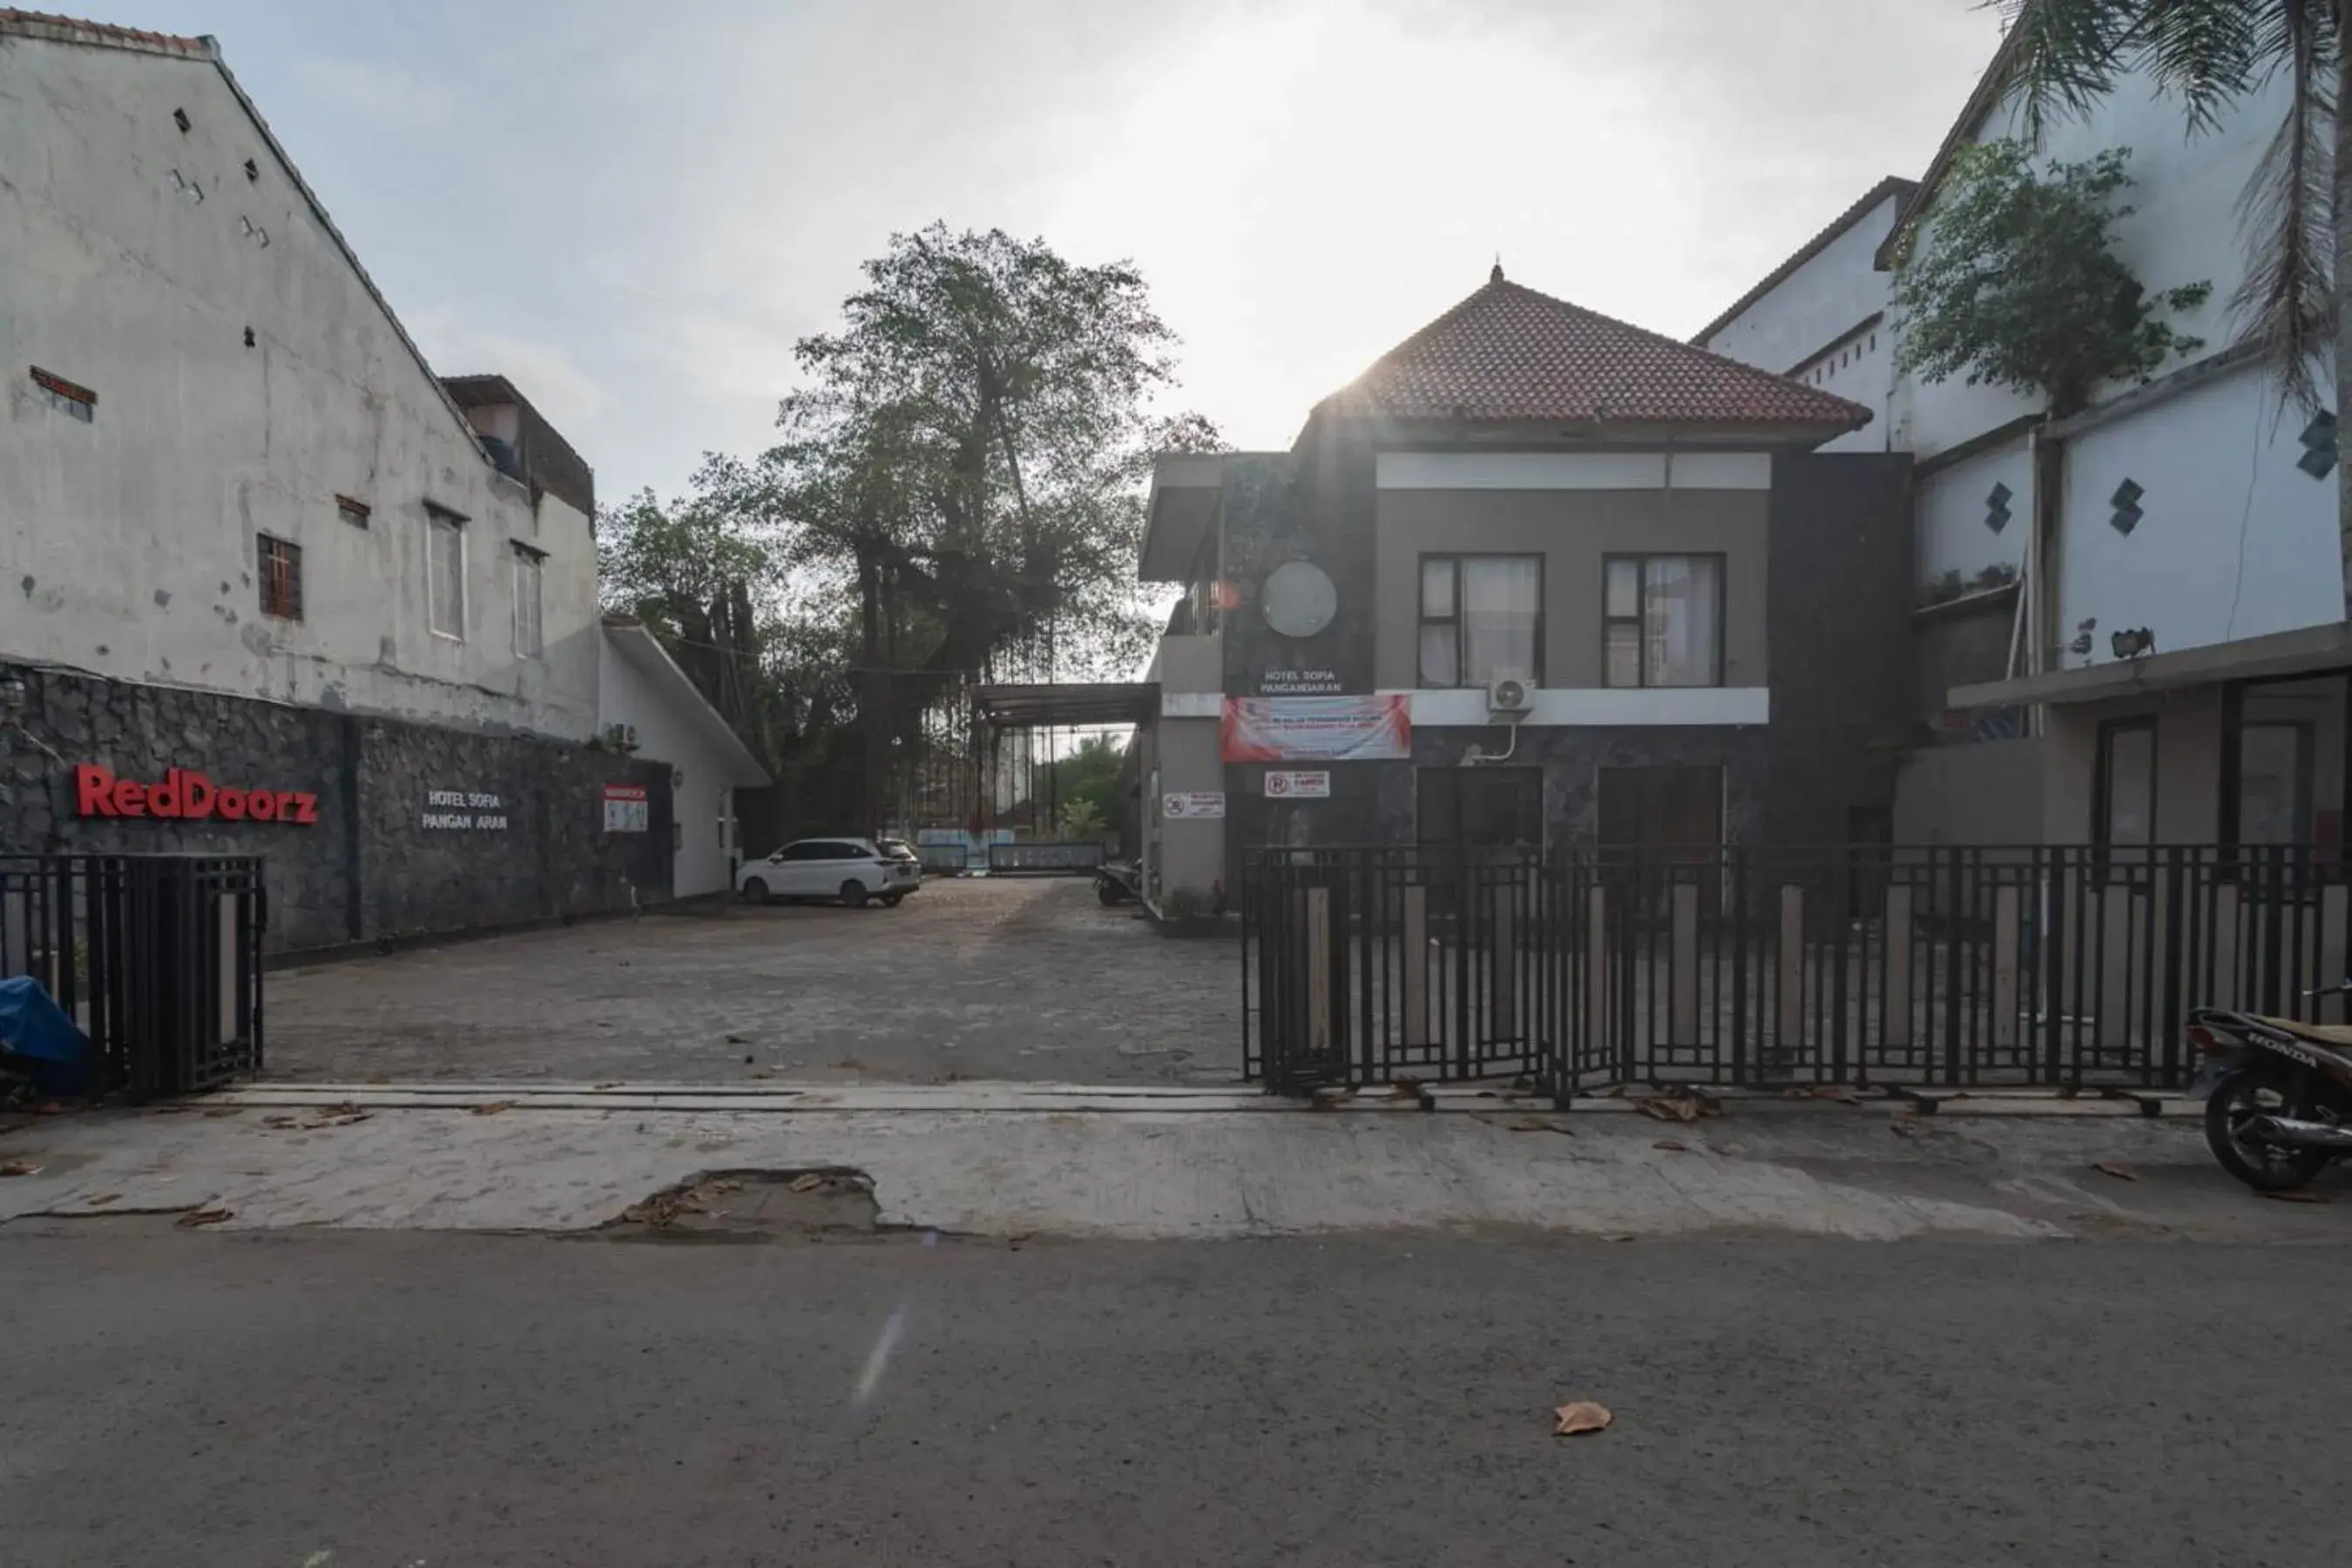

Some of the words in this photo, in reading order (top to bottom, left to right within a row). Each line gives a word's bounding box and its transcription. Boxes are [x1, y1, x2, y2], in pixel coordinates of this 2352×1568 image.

[1266, 671, 1298, 680] HOTEL
[1304, 671, 1335, 680] SOFIA
[76, 761, 319, 823] RedDoorz
[429, 791, 465, 807] HOTEL
[469, 793, 499, 808] SOFIA
[2247, 1032, 2317, 1068] HONDA
